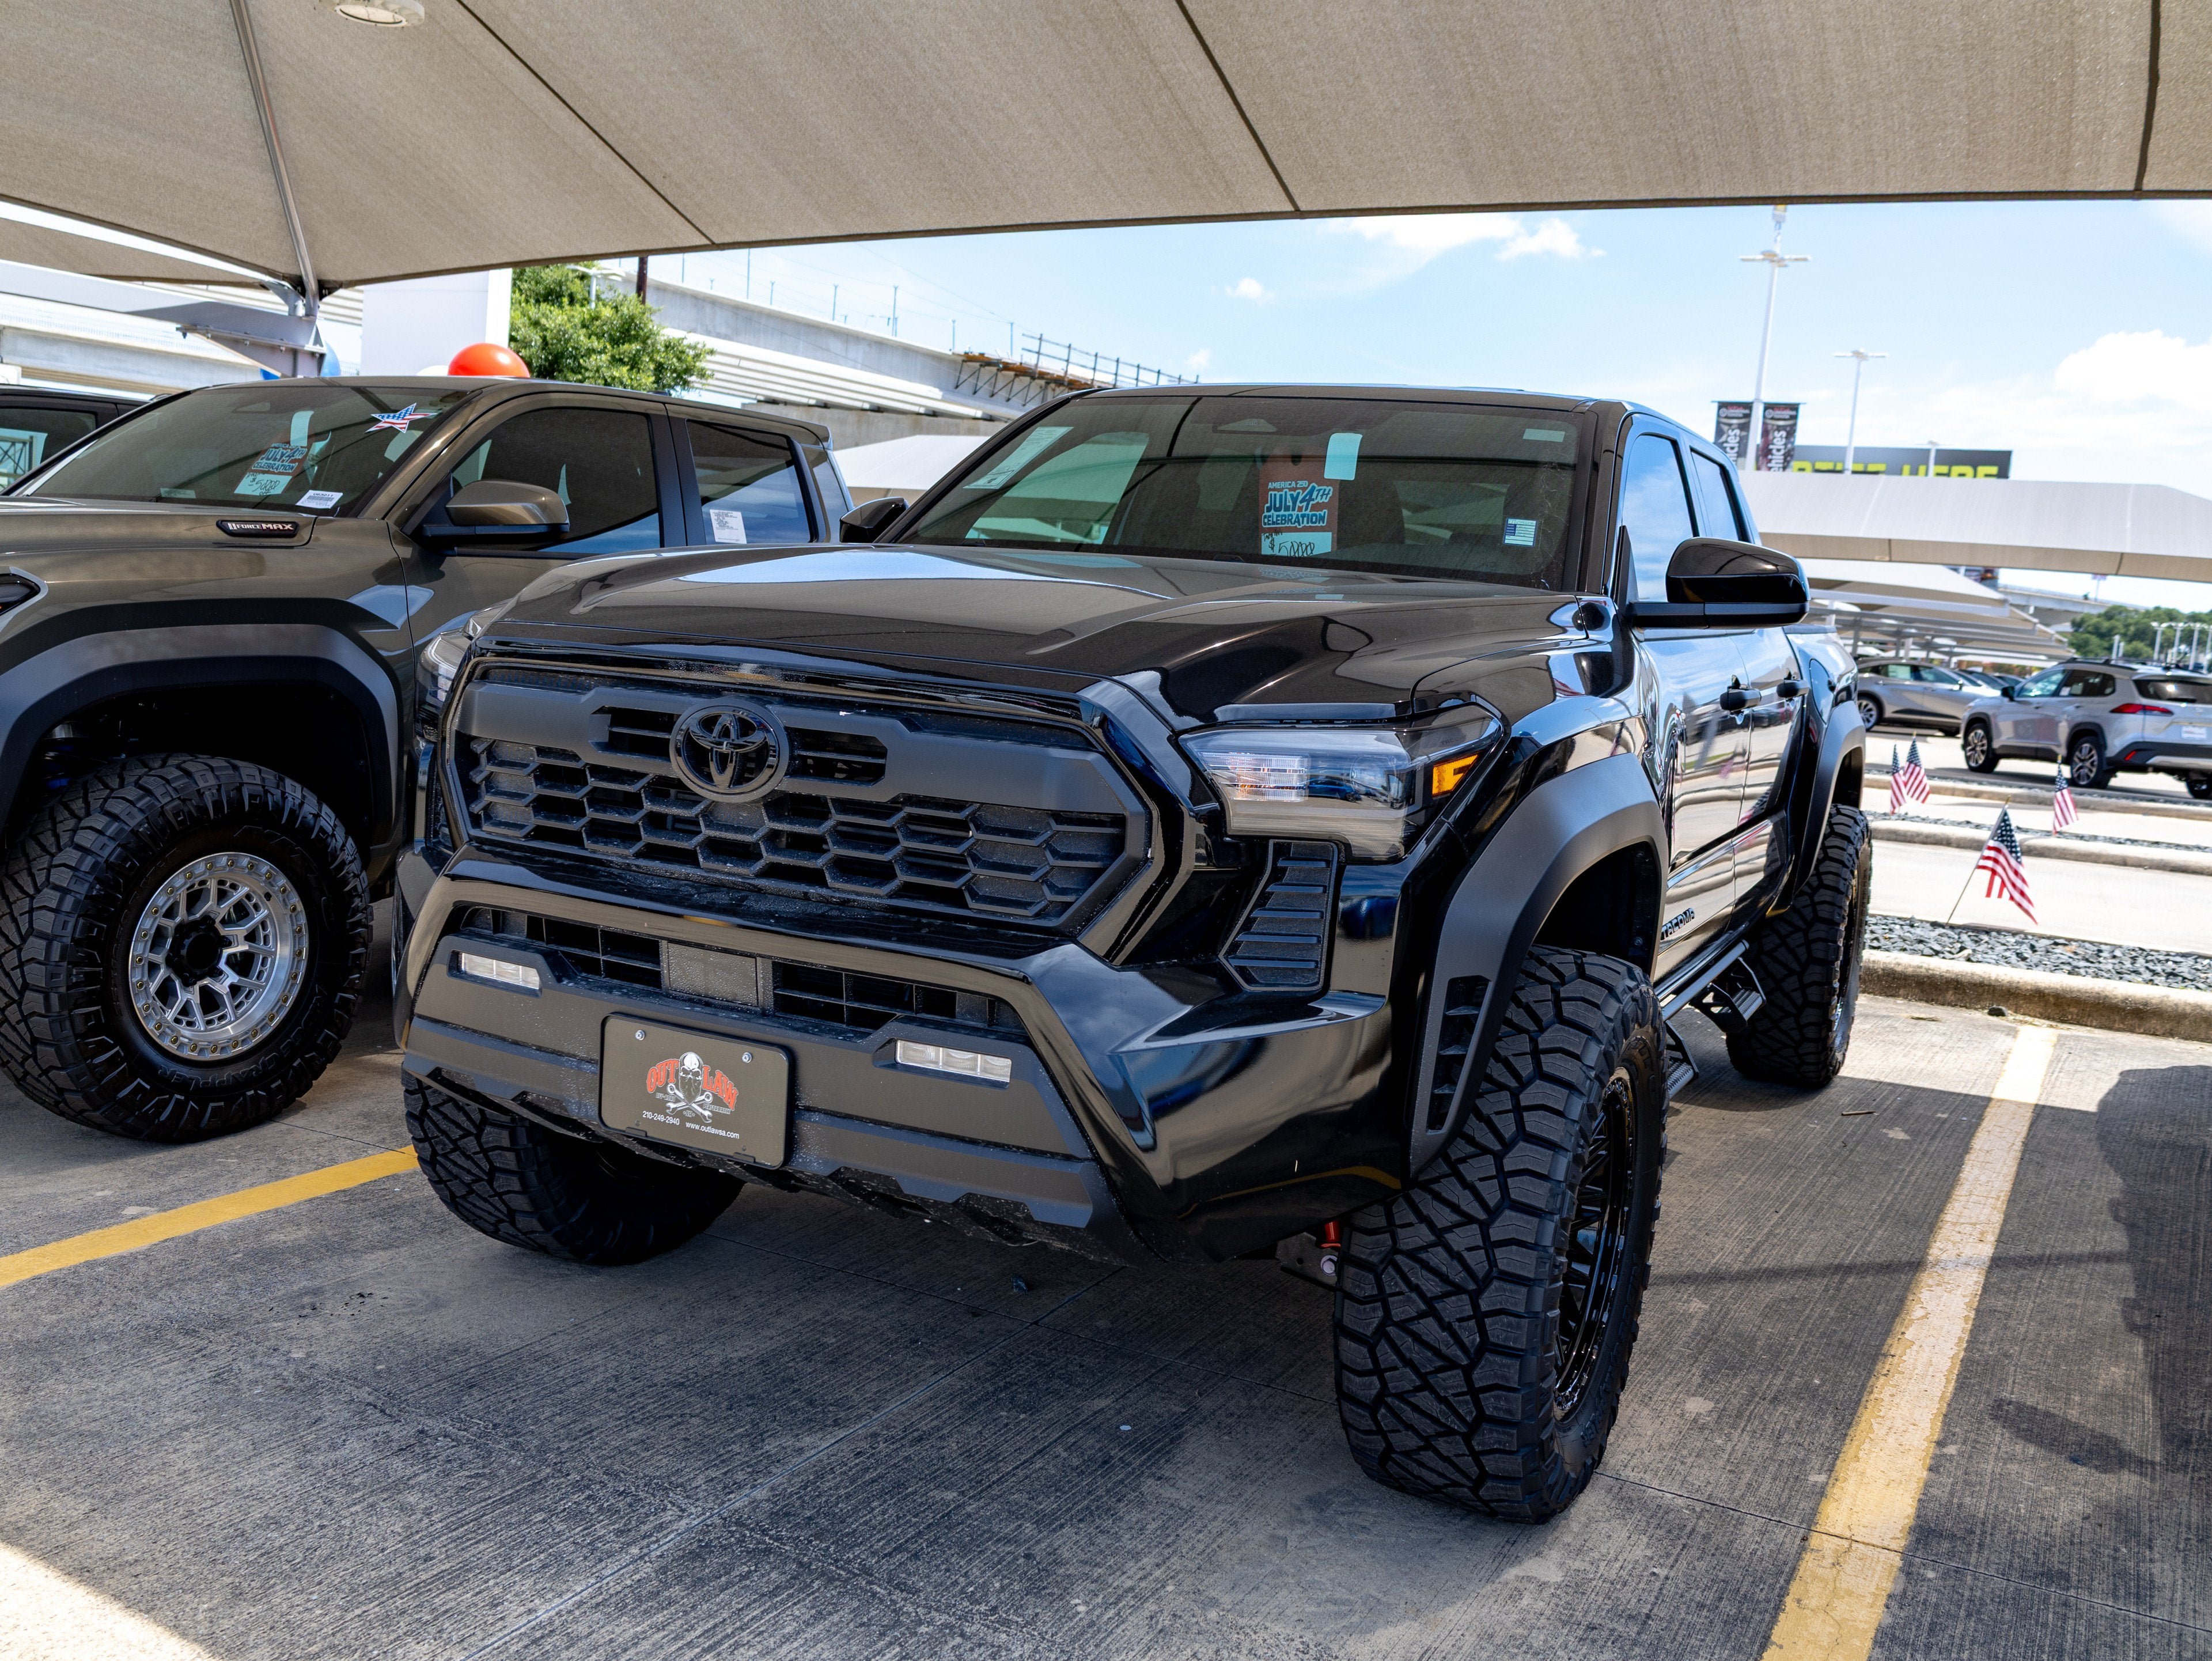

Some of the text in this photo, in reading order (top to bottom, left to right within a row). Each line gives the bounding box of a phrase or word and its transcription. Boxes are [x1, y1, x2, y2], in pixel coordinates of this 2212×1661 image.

[259, 446, 307, 463] JULY 4TH
[252, 461, 298, 472] CELEBRATION
[1268, 481, 1296, 489] AMERICA
[1266, 483, 1333, 513] JULY 4TH
[1263, 510, 1327, 527] CELEBRATION
[642, 1110, 680, 1126] 210-249-2940
[685, 1121, 740, 1140] www.outlawsa.com
